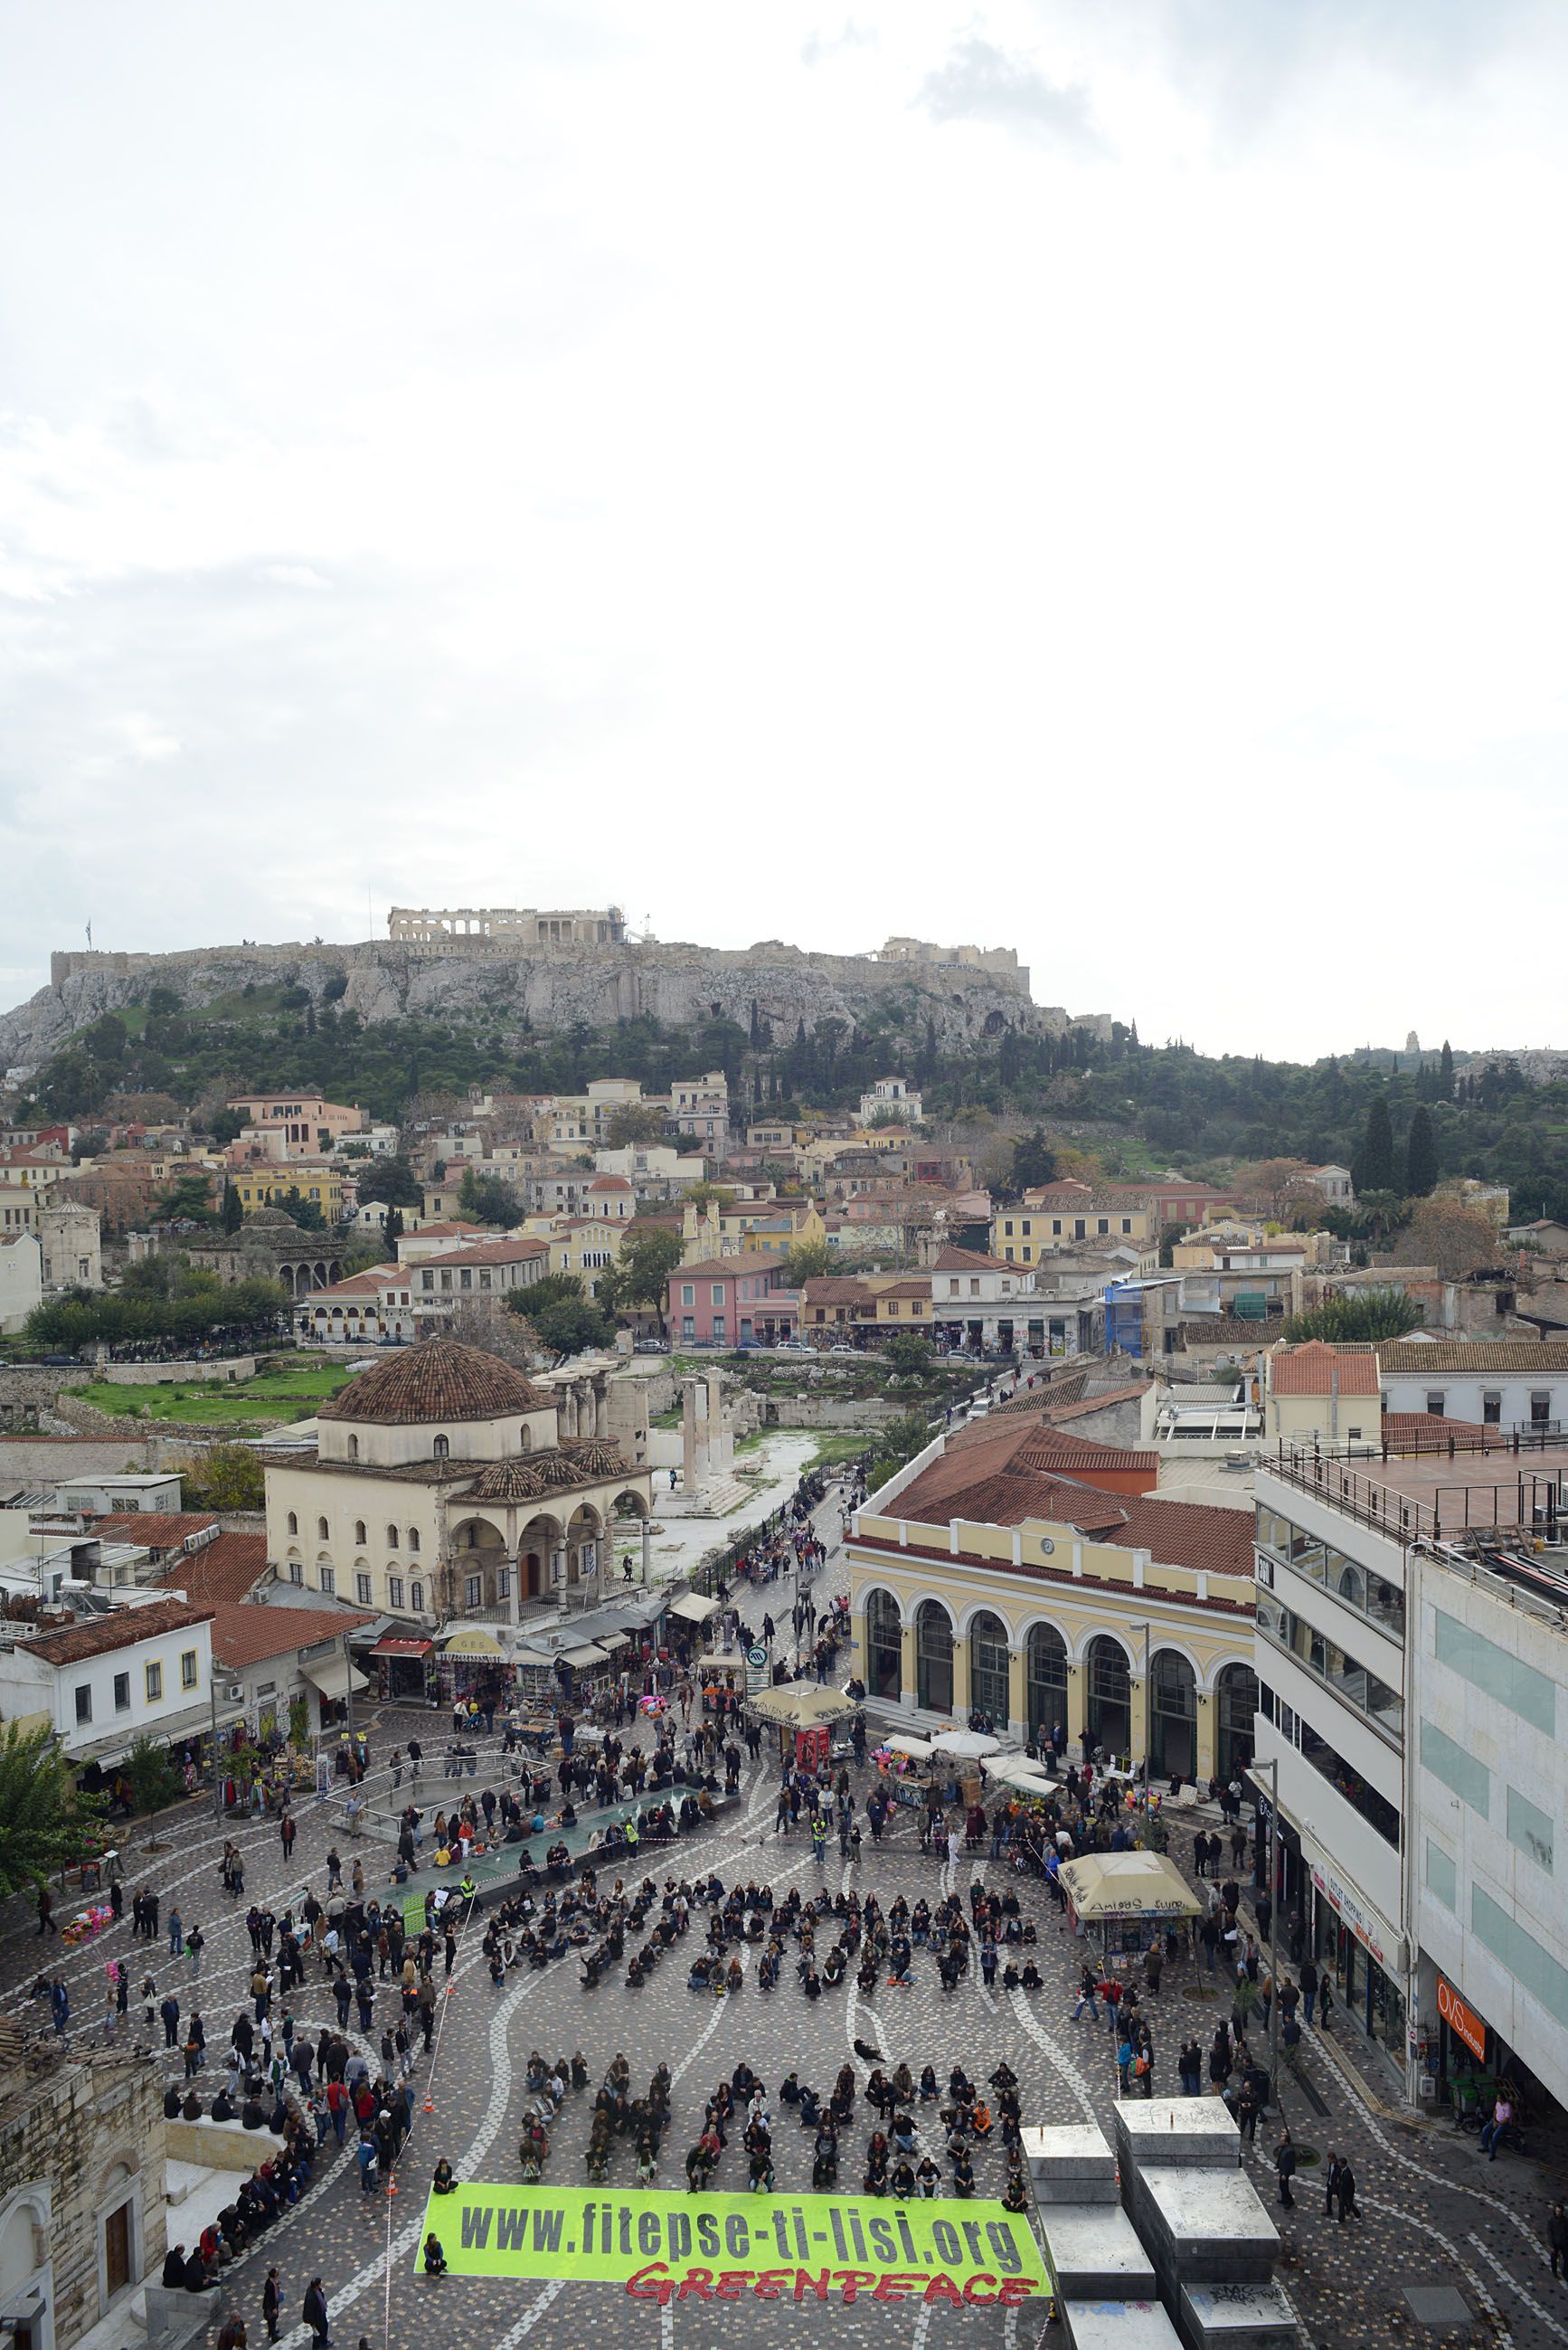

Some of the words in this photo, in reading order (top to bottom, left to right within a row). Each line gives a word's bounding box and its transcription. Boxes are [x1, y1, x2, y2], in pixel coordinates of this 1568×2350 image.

[1438, 1983, 1464, 2033] OVS
[460, 2203, 1023, 2274] www.fitepse-ti-lisi.org
[625, 2261, 1039, 2307] GREENPEACE
